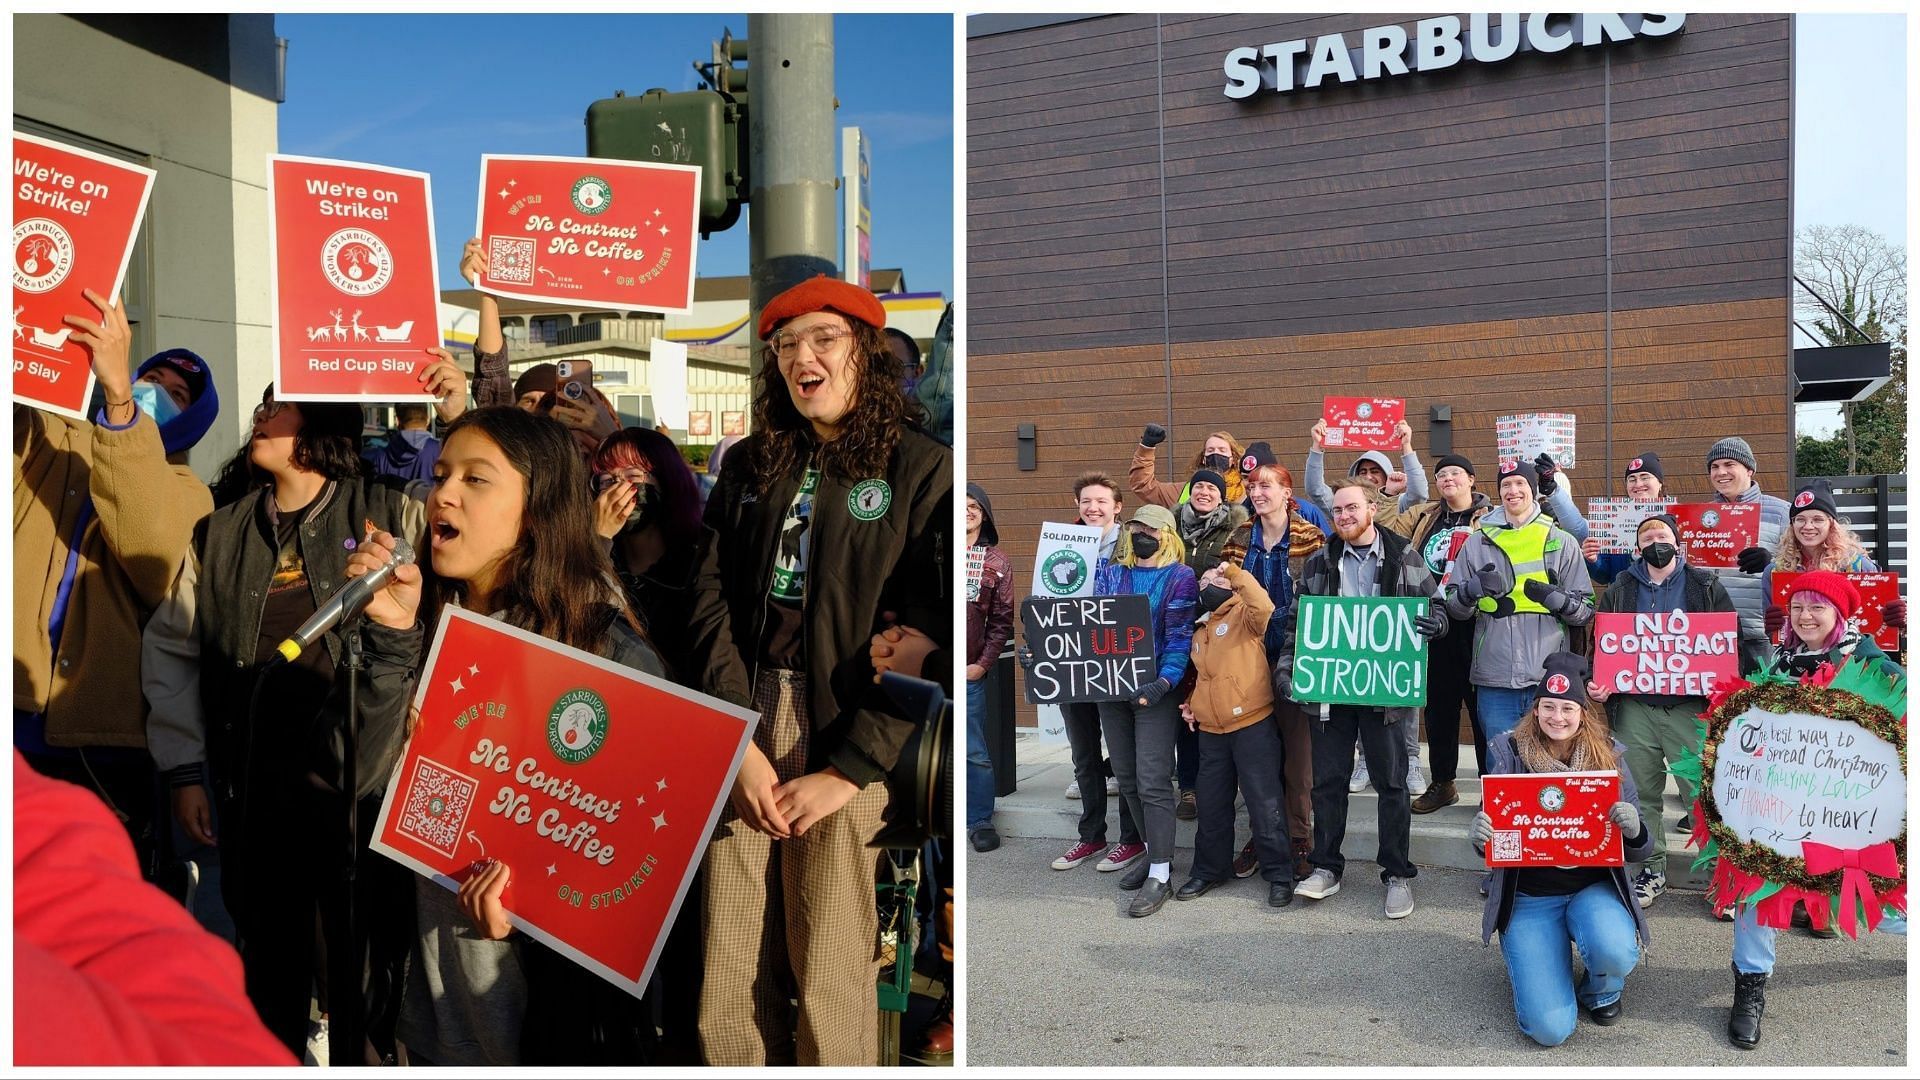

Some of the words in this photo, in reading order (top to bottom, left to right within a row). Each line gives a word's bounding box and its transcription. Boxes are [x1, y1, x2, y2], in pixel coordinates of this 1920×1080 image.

[14, 158, 75, 189] We're
[80, 180, 109, 199] on
[306, 179, 367, 199] We're
[373, 189, 399, 204] on
[18, 182, 91, 216] Strike!
[320, 200, 389, 221] Strike!
[15, 223, 69, 251] STARBUCKS
[525, 215, 556, 232] No
[559, 217, 638, 240] Contract
[331, 232, 384, 256] STARBUCKS
[548, 237, 580, 255] No
[584, 240, 645, 261] Coffee
[38, 257, 69, 289] UNITED
[327, 255, 361, 292] WORKERS
[367, 259, 388, 291] UNITED
[616, 275, 635, 286] ON
[27, 361, 61, 384] Slay
[308, 358, 340, 371] Red
[344, 358, 377, 374] Cup
[381, 358, 415, 374] Slay
[1348, 427, 1360, 435] No
[1361, 427, 1385, 435] Coffee
[1352, 419, 1383, 427] Contract
[1042, 532, 1099, 544] SOLIDARITY
[1682, 531, 1695, 539] No
[1696, 530, 1731, 538] Contract
[1691, 540, 1705, 548] No
[1707, 540, 1735, 548] Coffee
[1050, 551, 1064, 561] DSA
[1064, 551, 1078, 560] FOR
[1043, 571, 1068, 594] STARBUCKS
[1068, 575, 1085, 592] UNION
[1031, 599, 1117, 629] WE'RE
[1303, 602, 1424, 653] UNION
[1634, 608, 1690, 636] NO
[1044, 631, 1082, 660] ON
[1091, 625, 1146, 655] ULP
[1600, 631, 1737, 656] CONTRACT
[1294, 655, 1422, 698] STRONG!
[1638, 652, 1690, 674] NO
[1615, 669, 1718, 696] COFFEE
[454, 701, 507, 730] WE'RE
[560, 690, 606, 722] STARBUCKS
[549, 713, 569, 759] WORKERS
[574, 730, 605, 762] UNITED
[1770, 722, 1793, 744] best
[1798, 729, 1829, 748] way
[1836, 731, 1855, 747] to
[469, 738, 511, 773] No
[515, 757, 622, 823] Contract
[1583, 778, 1611, 787] Staffing
[1765, 764, 1817, 797] RALLYING
[1814, 749, 1889, 790] Christmas
[1725, 782, 1743, 807] for
[1740, 788, 1794, 825] HOWARD
[1799, 803, 1816, 828] to
[489, 786, 532, 824] No
[536, 808, 615, 866] Coffee
[1512, 814, 1532, 826] No
[1533, 814, 1584, 826] Contract
[1528, 827, 1549, 840] No
[1551, 827, 1591, 840] Coffee
[558, 884, 584, 908] ON
[590, 854, 658, 910] STRIKE!
